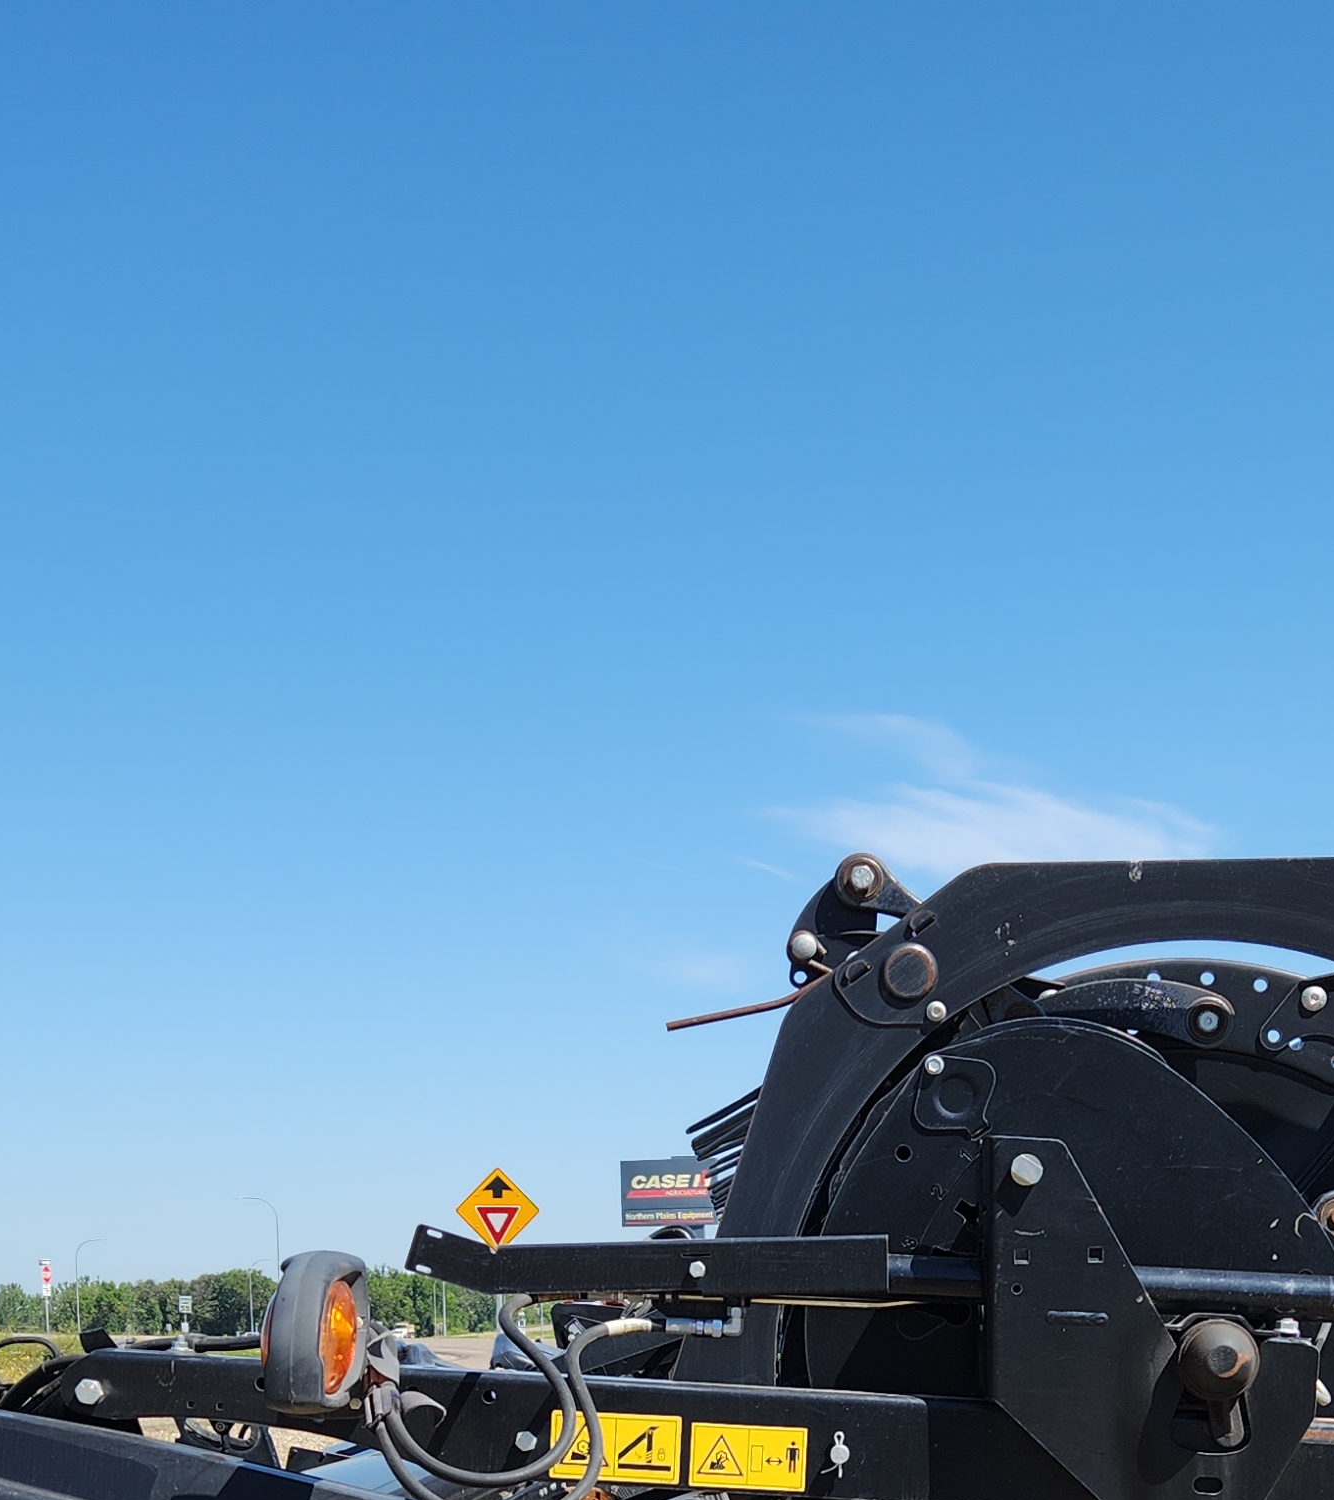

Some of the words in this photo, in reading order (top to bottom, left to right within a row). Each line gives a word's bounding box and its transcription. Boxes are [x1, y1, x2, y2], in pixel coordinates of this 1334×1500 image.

[631, 1174, 691, 1189] CASE
[625, 1212, 655, 1220] Northern
[656, 1212, 677, 1220] Plains
[678, 1211, 713, 1220] Equipment
